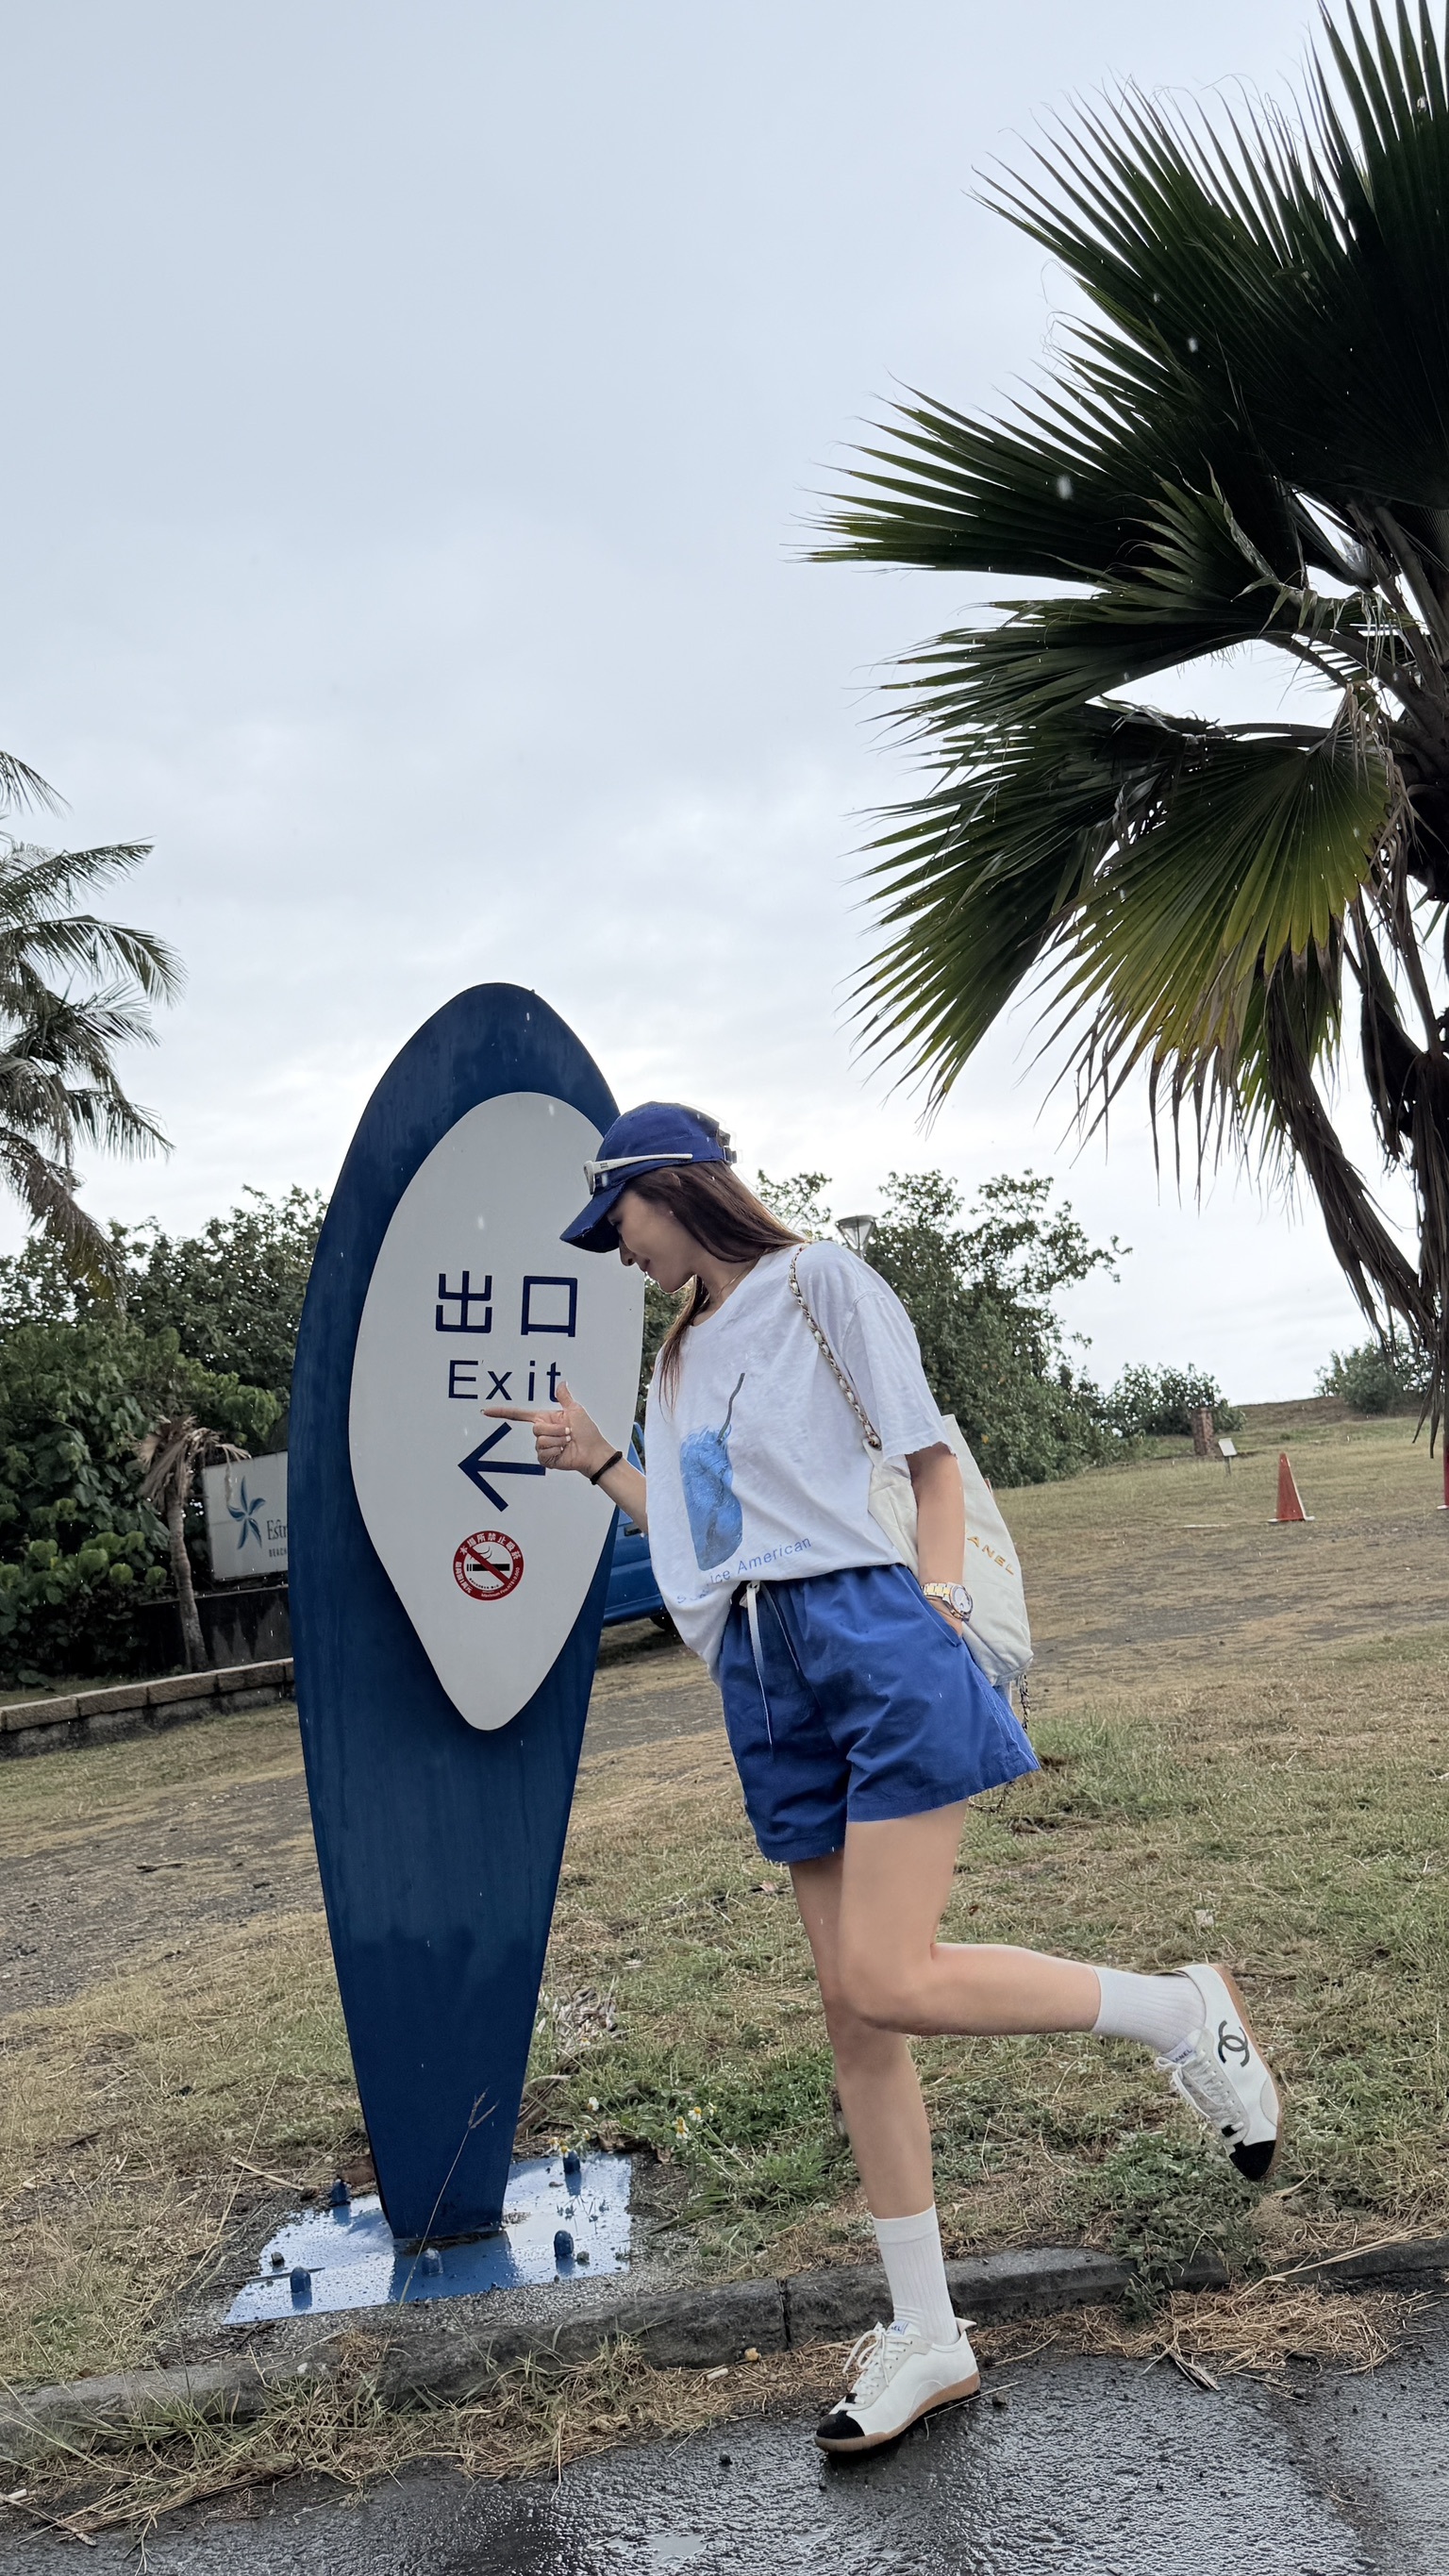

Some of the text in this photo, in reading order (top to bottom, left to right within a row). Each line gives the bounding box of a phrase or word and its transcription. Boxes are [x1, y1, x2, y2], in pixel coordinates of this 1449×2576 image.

[436, 1270, 578, 1338] 出口
[448, 1360, 562, 1403] Exit
[737, 1537, 812, 1574] American
